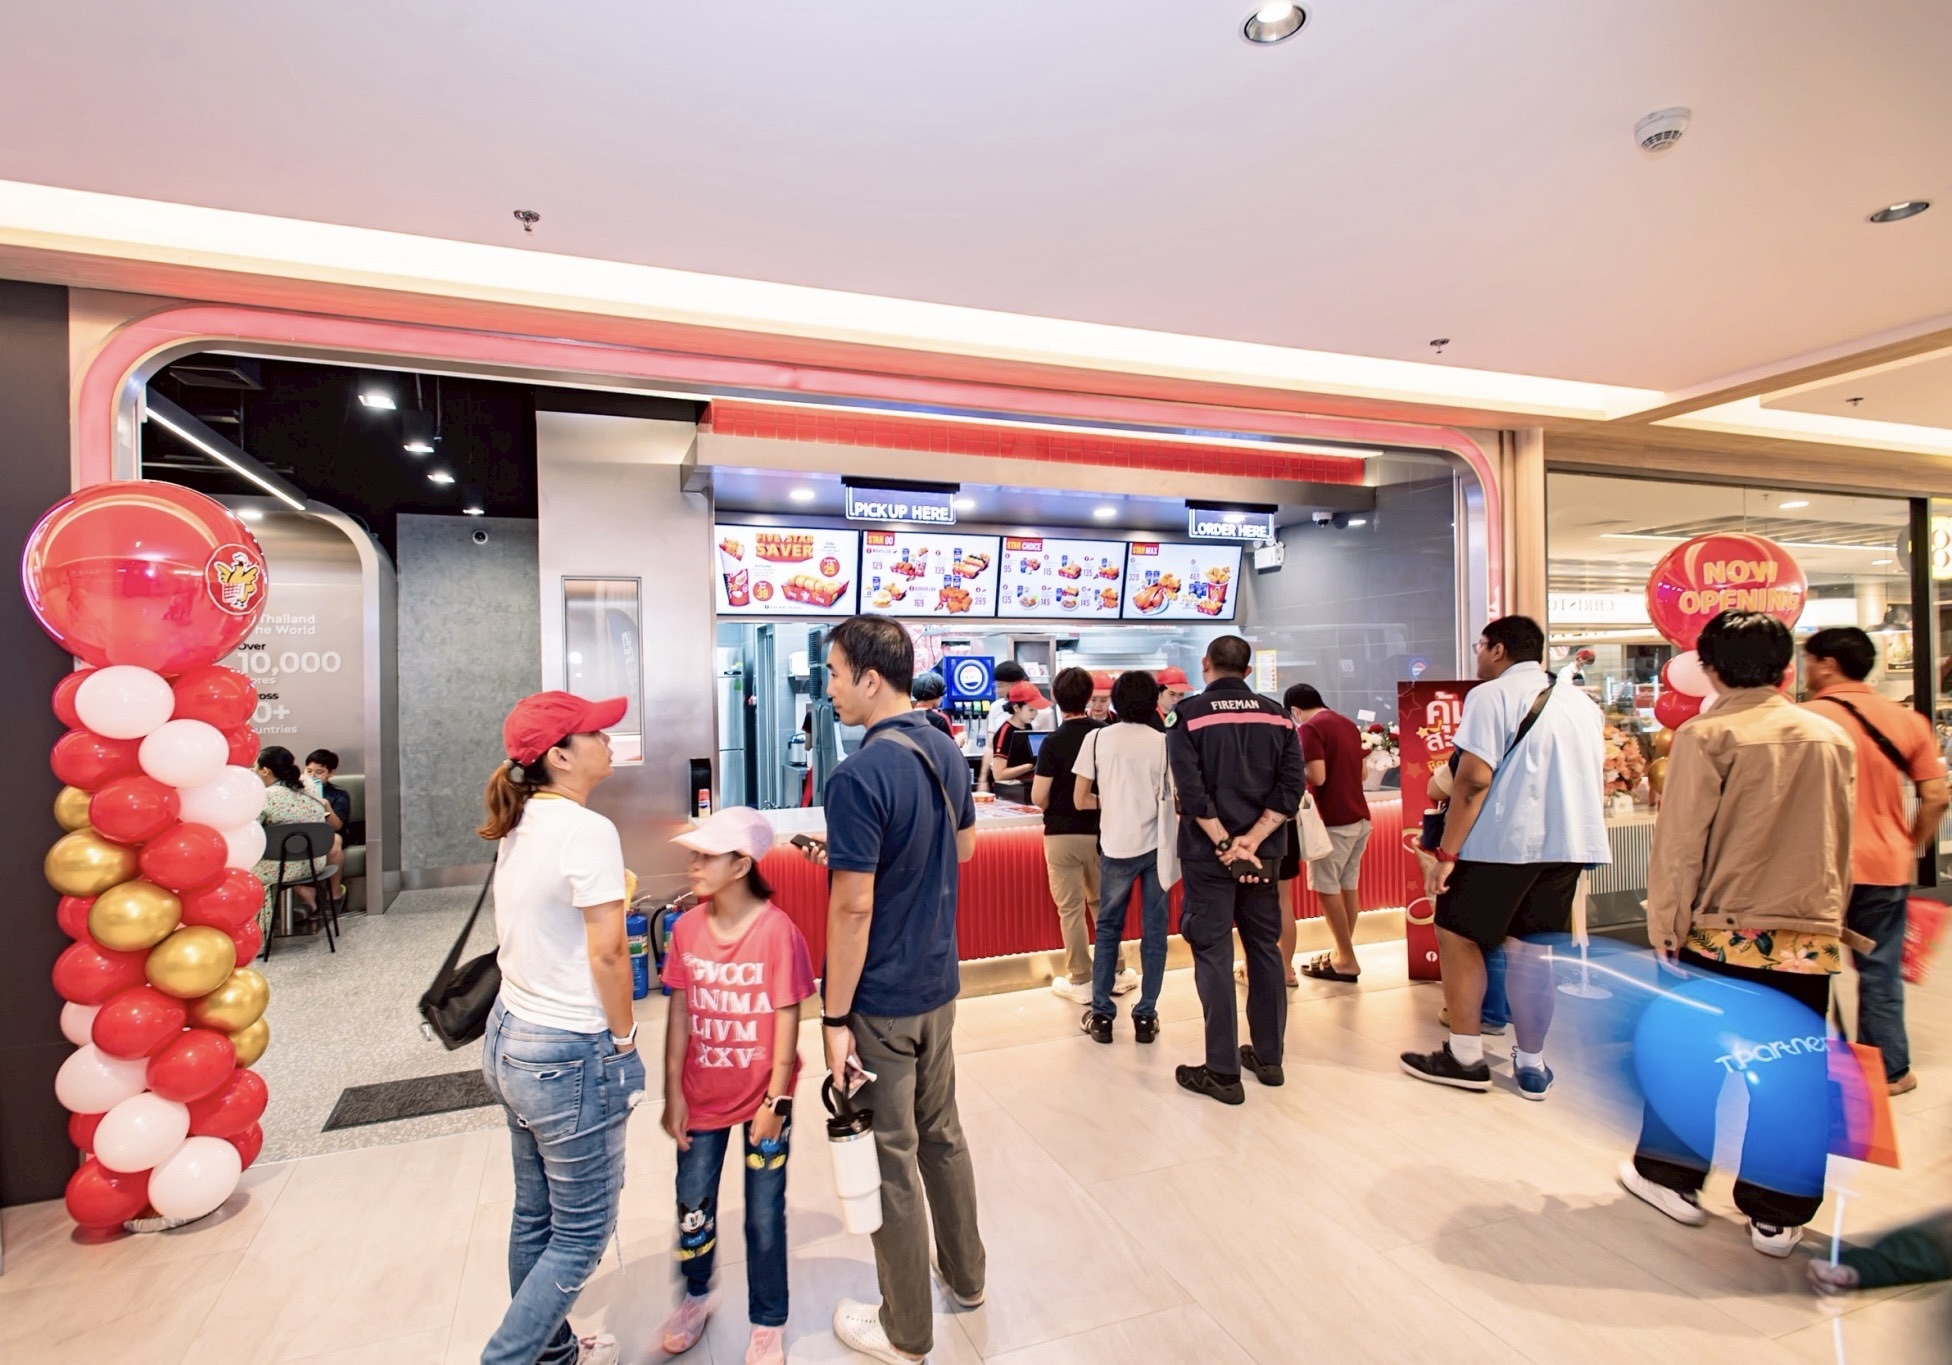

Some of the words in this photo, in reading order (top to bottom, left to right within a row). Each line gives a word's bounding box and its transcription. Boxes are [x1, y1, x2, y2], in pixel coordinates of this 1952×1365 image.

[854, 501, 888, 518] PICK
[887, 503, 909, 519] UP
[911, 504, 949, 521] HERE
[1197, 522, 1236, 537] ORDER
[1238, 524, 1267, 538] HERE
[756, 533, 781, 544] FIVE
[785, 534, 814, 545] STAR
[867, 536, 884, 544] STAR
[756, 542, 814, 557] SAVER
[1006, 541, 1021, 550] STAR
[1021, 542, 1042, 551] CHOICE
[1145, 547, 1158, 555] MAX
[872, 561, 883, 570] 129
[935, 566, 946, 575] 139
[1703, 560, 1778, 585] NOW
[1679, 587, 1800, 615] OPENING
[260, 614, 316, 624] Thailand
[255, 626, 272, 635] he
[275, 626, 316, 635] World
[237, 651, 342, 676] 10,000
[1210, 699, 1260, 710] FIREMAN
[692, 1014, 759, 1042] LIVM
